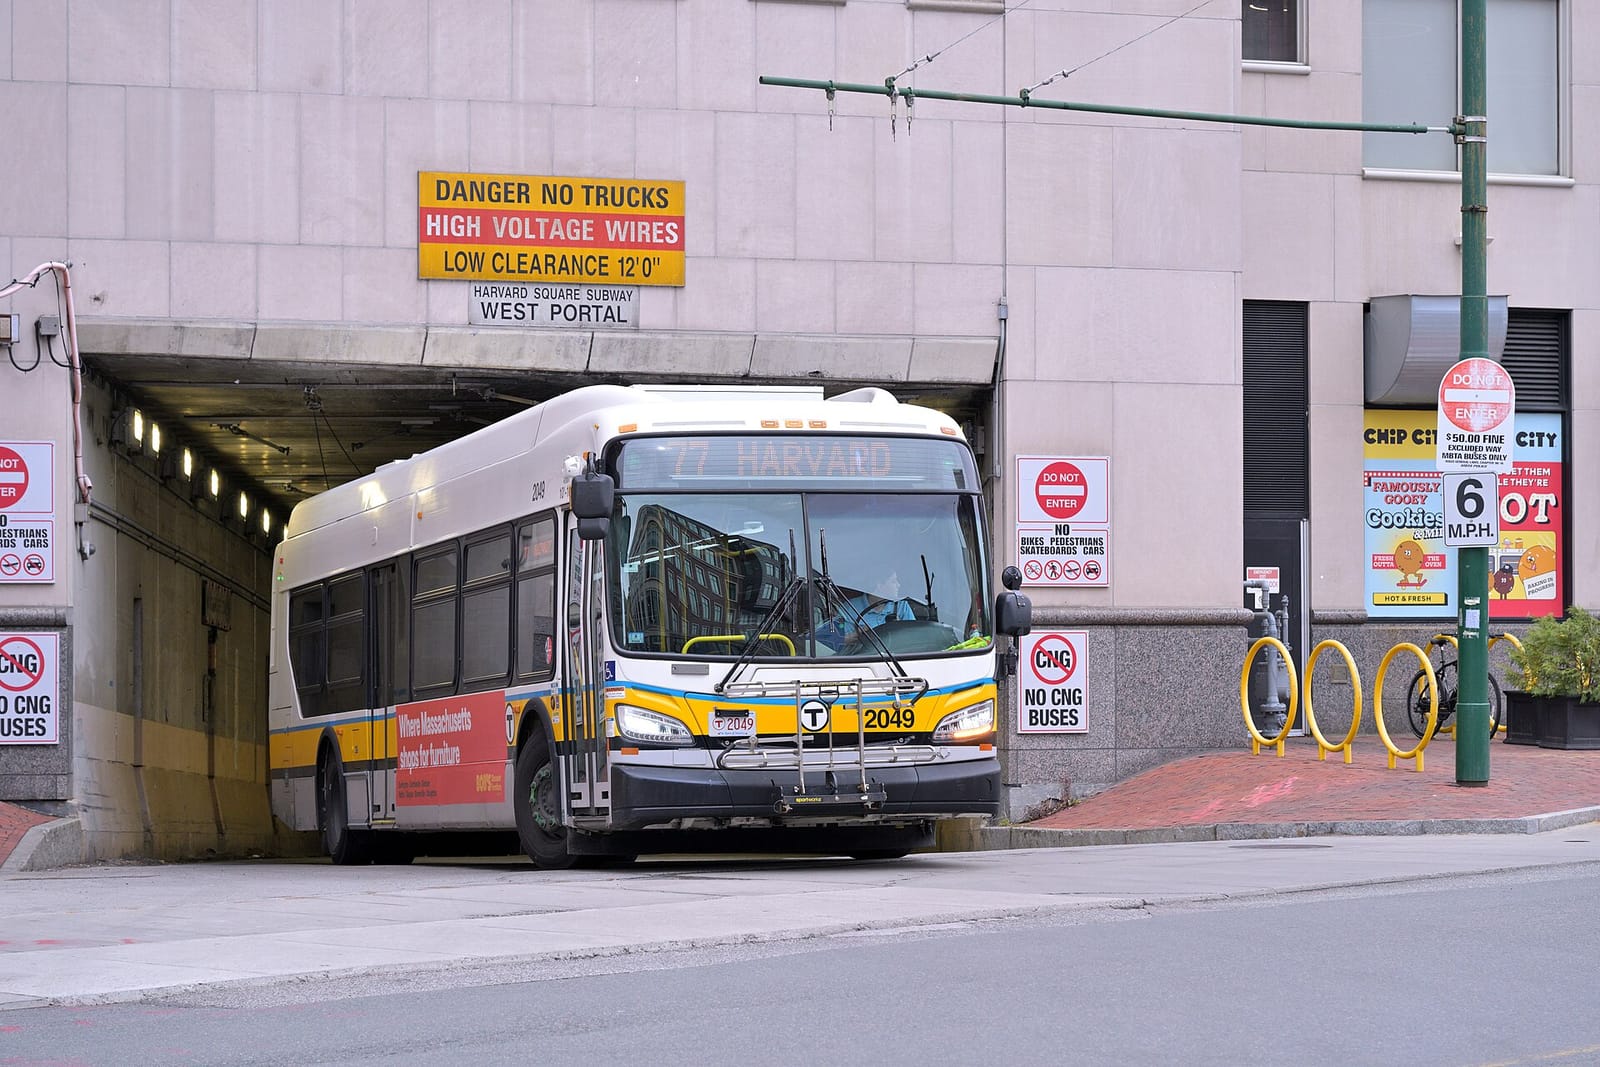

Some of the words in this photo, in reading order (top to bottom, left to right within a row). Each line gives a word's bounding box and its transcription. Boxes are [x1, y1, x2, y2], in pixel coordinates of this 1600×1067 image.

[436, 180, 530, 204] DANGER
[542, 183, 574, 206] NO
[581, 185, 669, 209] TRUCKS
[426, 214, 481, 237] HIGH
[492, 216, 594, 241] VOLTAGE
[605, 220, 679, 244] WIRES
[444, 251, 485, 273] LOW
[492, 252, 609, 277] CLEARANCE
[474, 286, 528, 299] HARVARD
[534, 288, 580, 301] SQUARE
[586, 289, 633, 302] SUBWAY
[480, 302, 538, 321] WEST
[550, 304, 628, 323] PORTAL
[1453, 374, 1472, 385] DO
[1477, 375, 1504, 386] NOT
[1455, 408, 1497, 419] ENTER
[1446, 432, 1480, 443] $50.00
[1482, 434, 1505, 444] FINE
[1448, 444, 1484, 452] EXCLUDED
[1485, 445, 1502, 453] WAY
[668, 440, 709, 476] 77
[737, 440, 891, 476] HARVARD
[1043, 473, 1057, 482] DO
[1060, 473, 1079, 482] NOT
[1524, 467, 1551, 476] THEM
[1373, 482, 1441, 493] FAMOUSLY
[1510, 478, 1549, 487] THEY'RE
[532, 480, 545, 502] 2049
[1456, 478, 1485, 519] 6
[1046, 499, 1077, 508] ENTER
[1384, 494, 1428, 505] GOOEY
[1499, 492, 1559, 524] OT
[0, 514, 7, 527] O
[1366, 507, 1443, 529] Cookies
[0, 528, 48, 539] ESTRIANS
[1055, 524, 1070, 536] NO
[1413, 530, 1423, 540] &
[1448, 523, 1494, 539] M.P.H.
[23, 538, 49, 548] CARS
[1021, 537, 1045, 546] BIKES
[1050, 537, 1104, 546] PEDESTRIANS
[1020, 546, 1077, 555] SKATEBOARDS
[1083, 546, 1105, 555] CARS
[1528, 578, 1547, 589] BAKING
[0, 654, 37, 673] CNG
[1036, 650, 1071, 669] CNG
[0, 695, 8, 714] O
[14, 695, 51, 714] CNG
[1025, 688, 1047, 706] NO
[1051, 688, 1082, 706] CNG
[398, 713, 420, 738] Where
[421, 707, 472, 736] Massachusetts
[727, 717, 754, 731] 2049
[864, 709, 915, 729] 2049
[1029, 708, 1079, 726] BUSES
[1, 718, 46, 737] USES
[400, 745, 419, 775] shops
[419, 743, 429, 768] for
[430, 740, 461, 768] furniture
